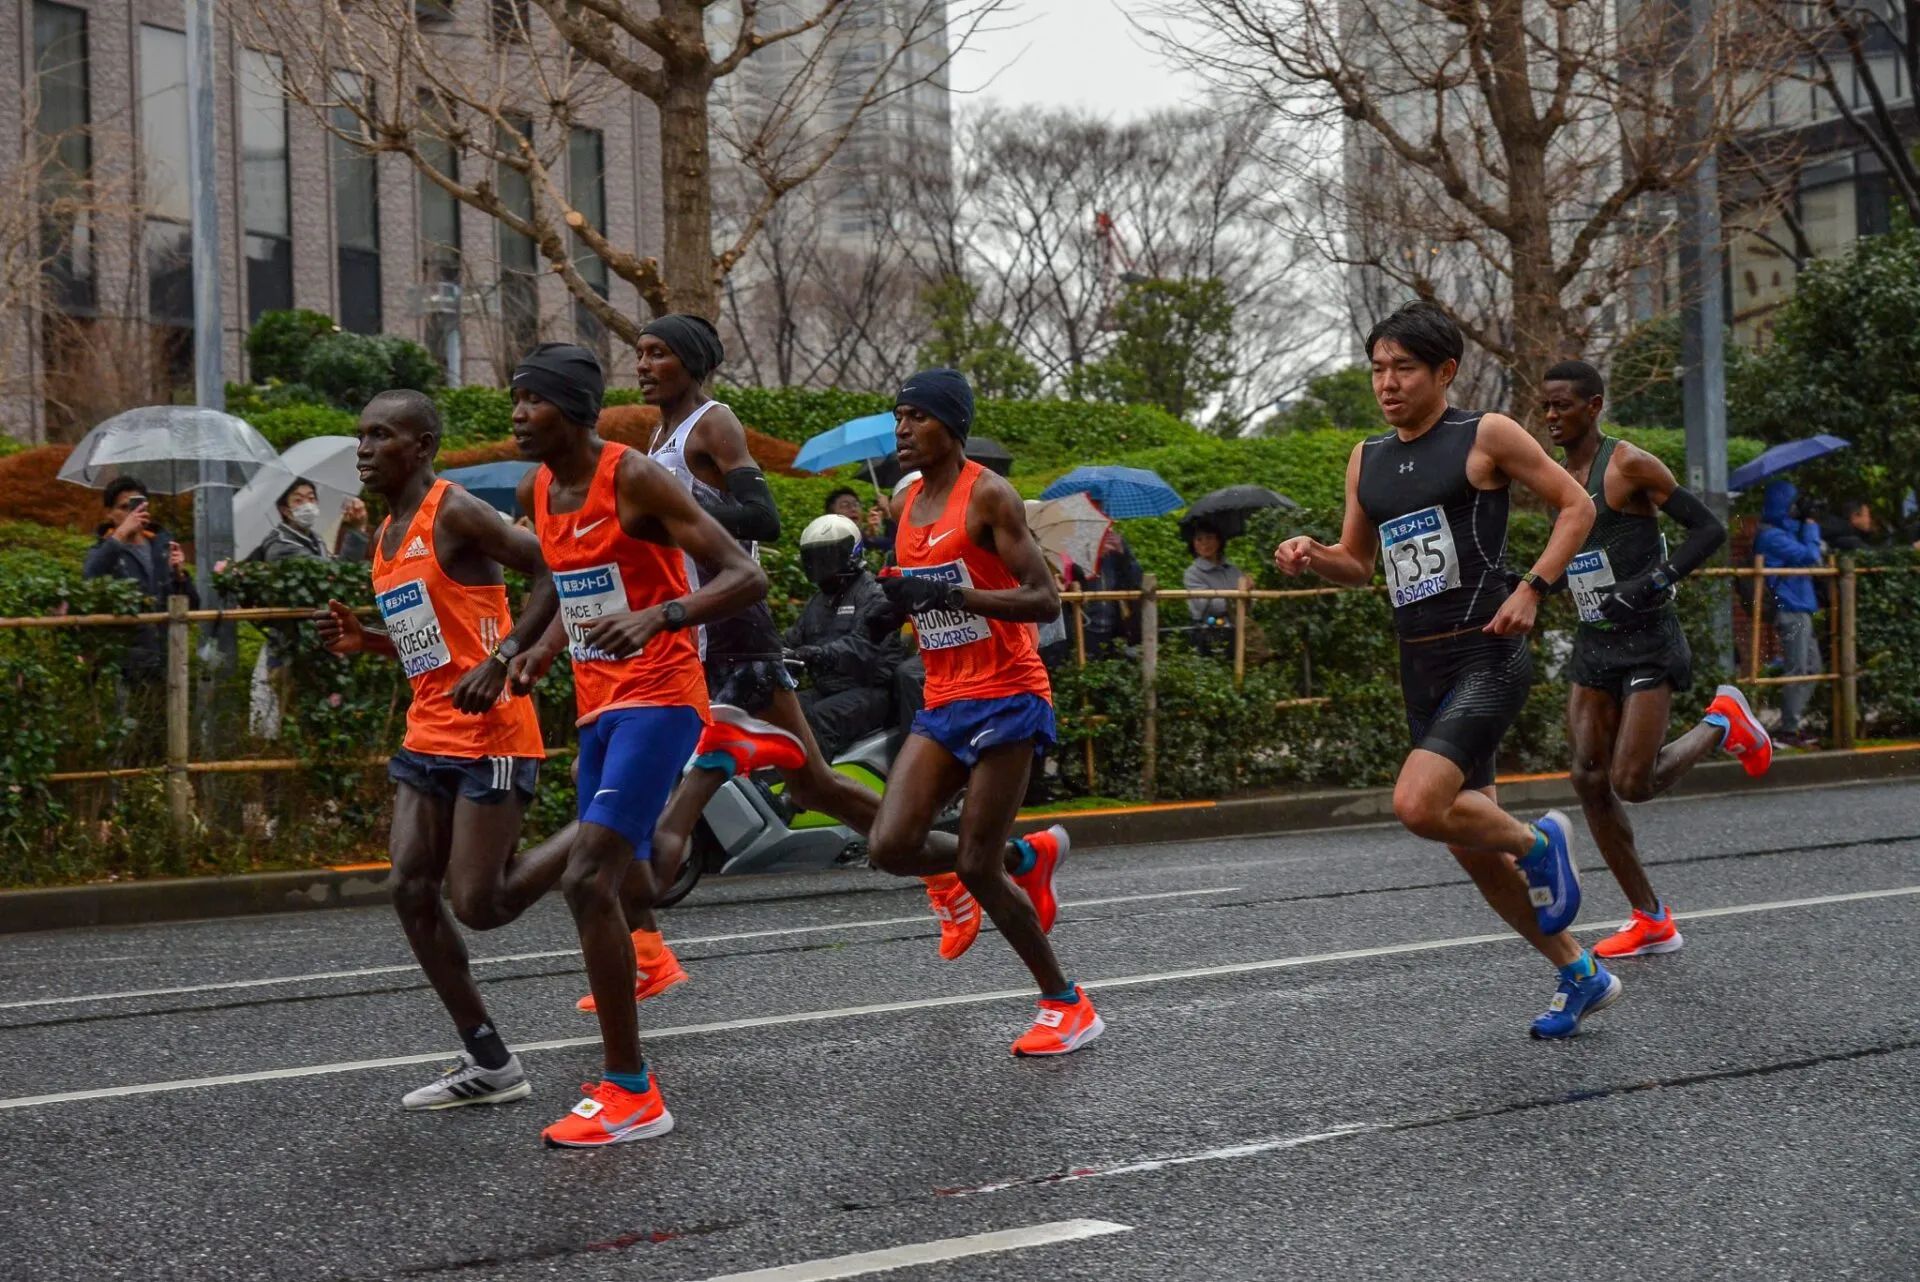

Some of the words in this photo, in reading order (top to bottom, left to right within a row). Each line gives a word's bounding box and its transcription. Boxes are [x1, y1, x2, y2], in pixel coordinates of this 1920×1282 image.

[1390, 515, 1436, 538] 東京メトロ
[404, 548, 429, 559] adidas
[1388, 534, 1446, 588] 135
[562, 575, 608, 593] 東京メトロ
[384, 589, 418, 610] 東京メトロ
[564, 604, 592, 620] PACE
[595, 603, 604, 617] 3
[387, 619, 408, 637] PACE
[397, 625, 441, 658] KOECH
